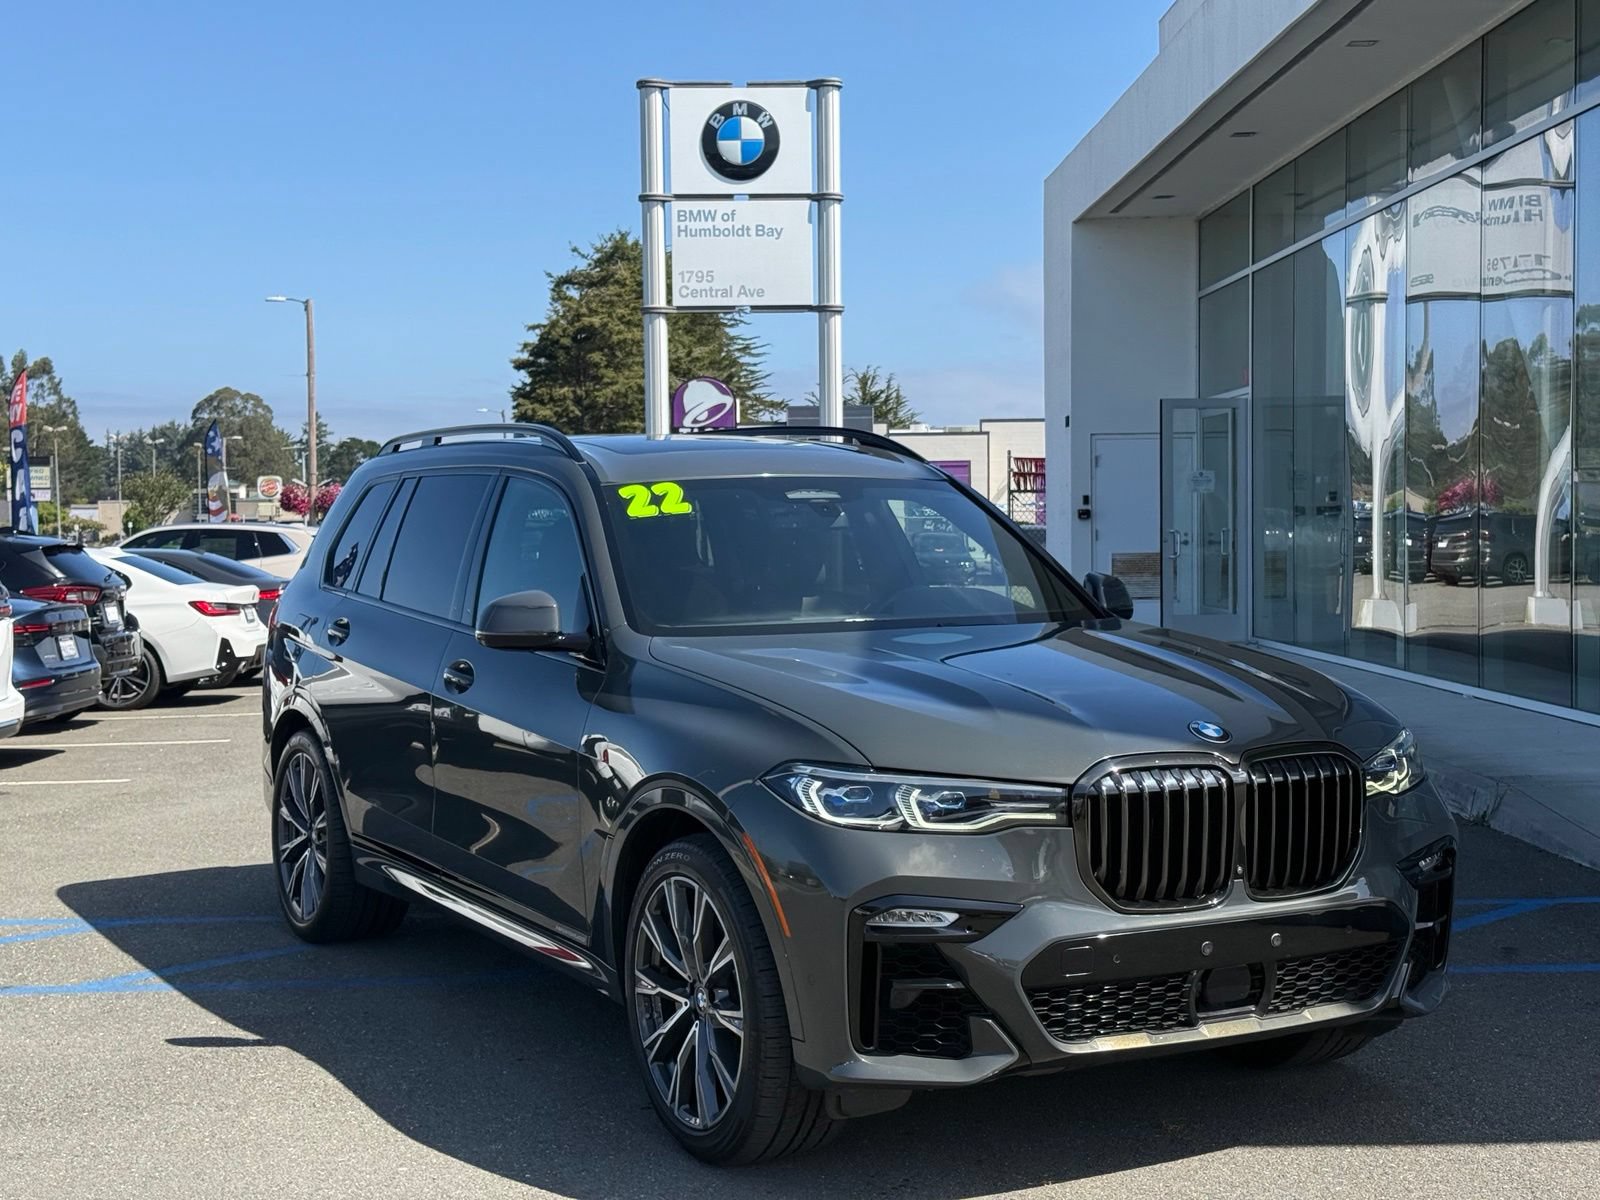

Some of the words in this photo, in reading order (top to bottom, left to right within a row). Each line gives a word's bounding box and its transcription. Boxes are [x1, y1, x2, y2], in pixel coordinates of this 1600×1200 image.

[708, 102, 774, 130] BMW
[677, 209, 717, 223] BMW
[721, 209, 736, 223] of
[677, 224, 751, 238] Humboldt
[755, 224, 784, 240] Bay
[678, 270, 715, 284] 1795
[678, 285, 733, 299] Central
[737, 285, 765, 298] Ave
[618, 482, 692, 518] 22
[664, 852, 691, 862] ZERO
